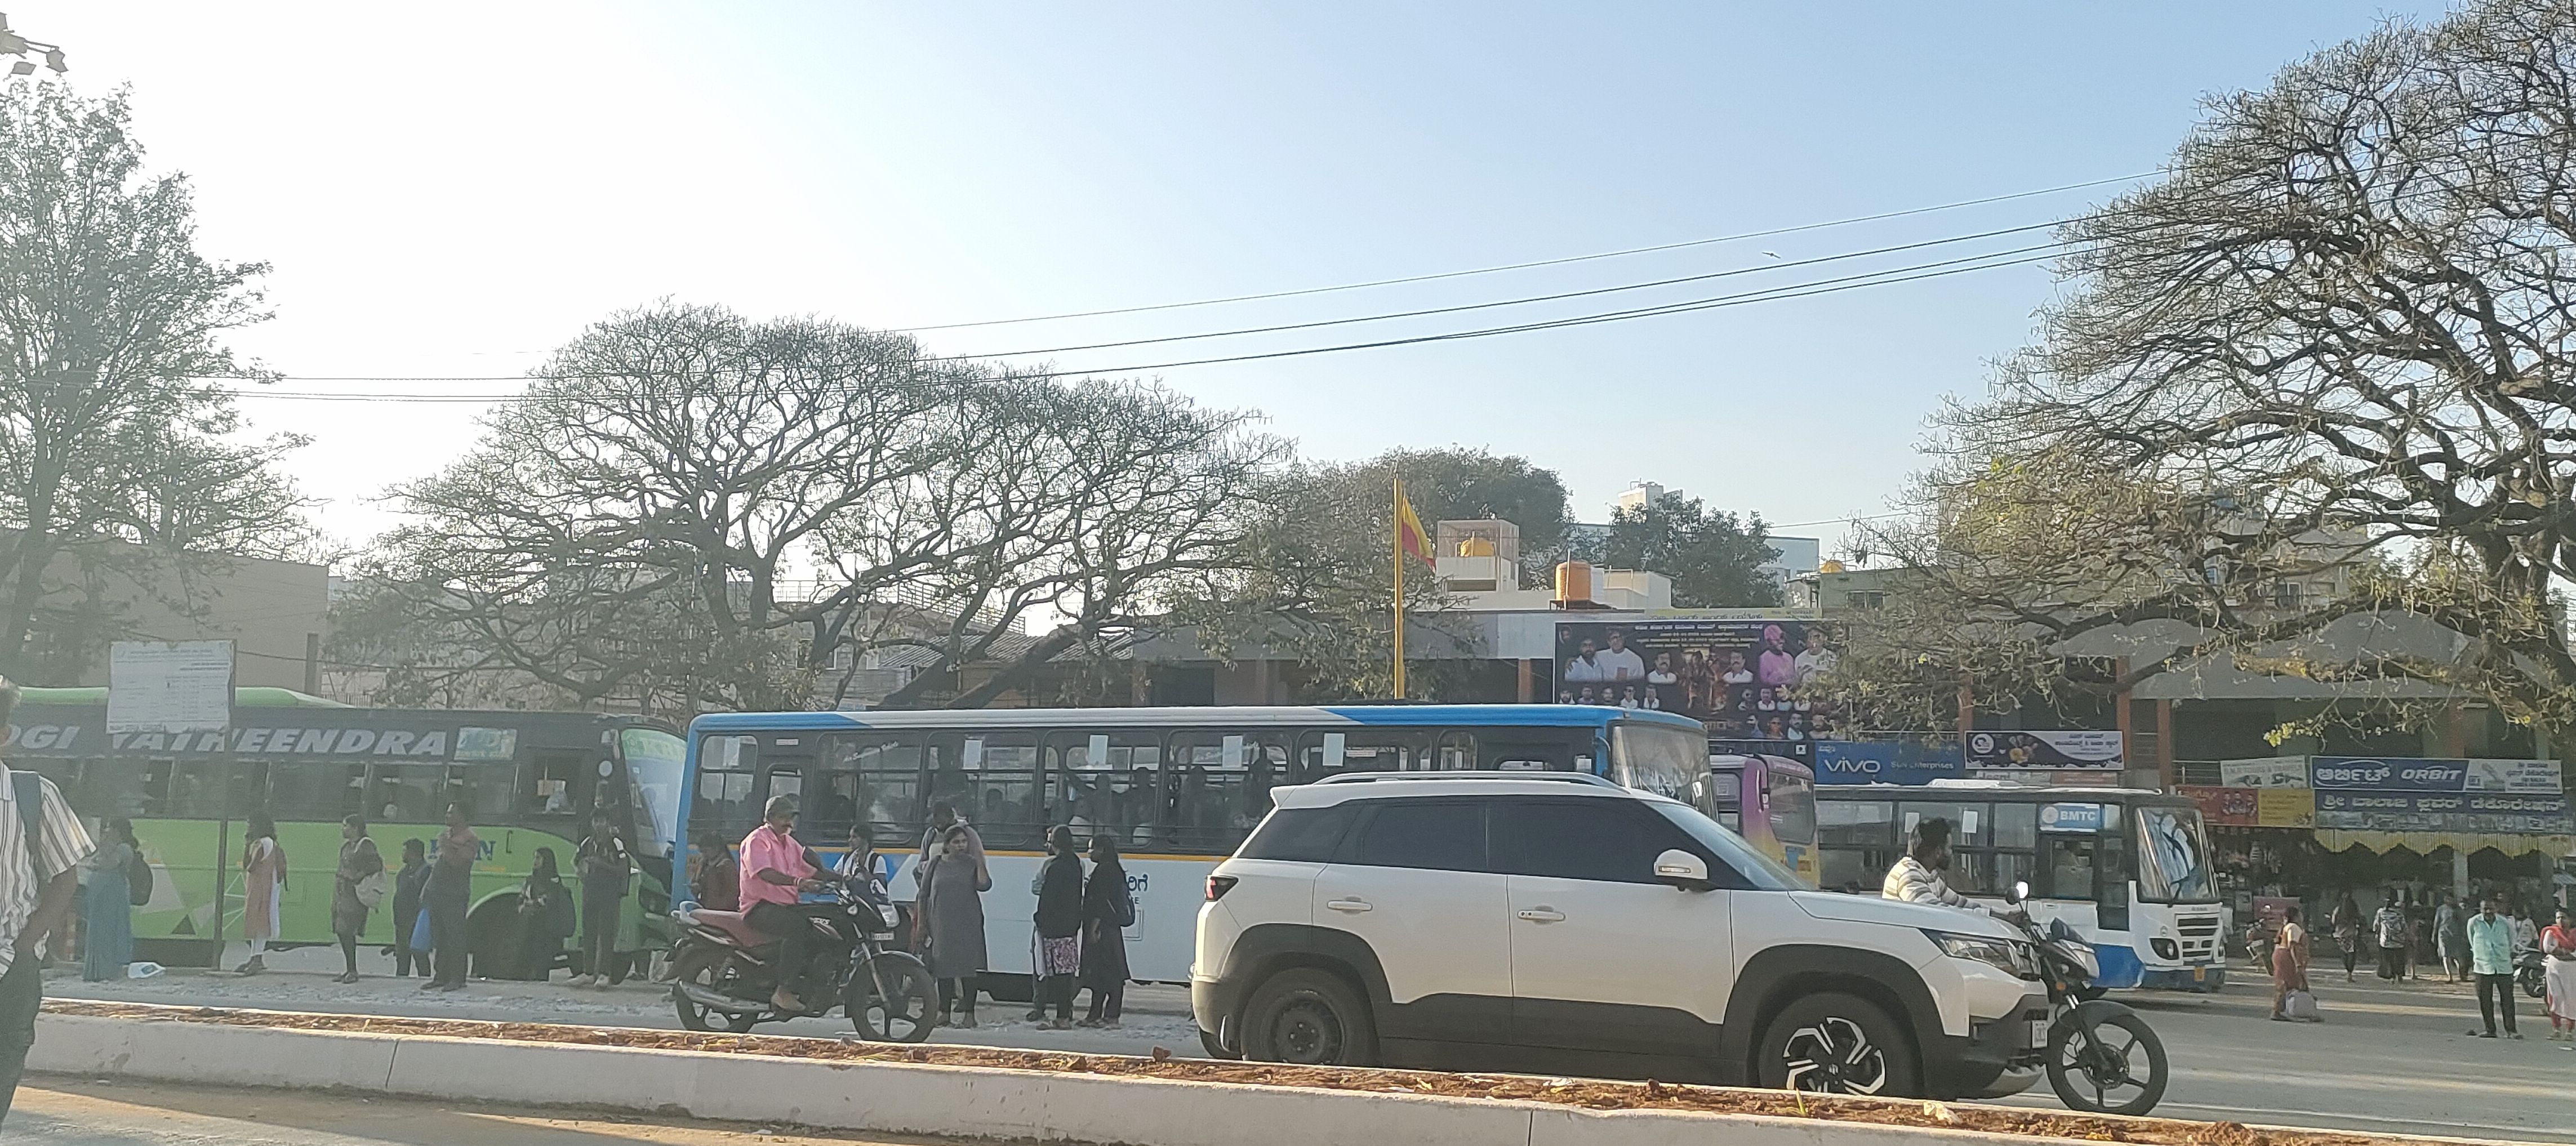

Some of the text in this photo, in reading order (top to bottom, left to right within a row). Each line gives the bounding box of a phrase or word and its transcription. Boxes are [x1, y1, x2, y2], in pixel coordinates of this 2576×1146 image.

[1824, 756, 1881, 773] vivo
[2401, 768, 2462, 781] ORBIT
[2060, 811, 2095, 821] BMTC
